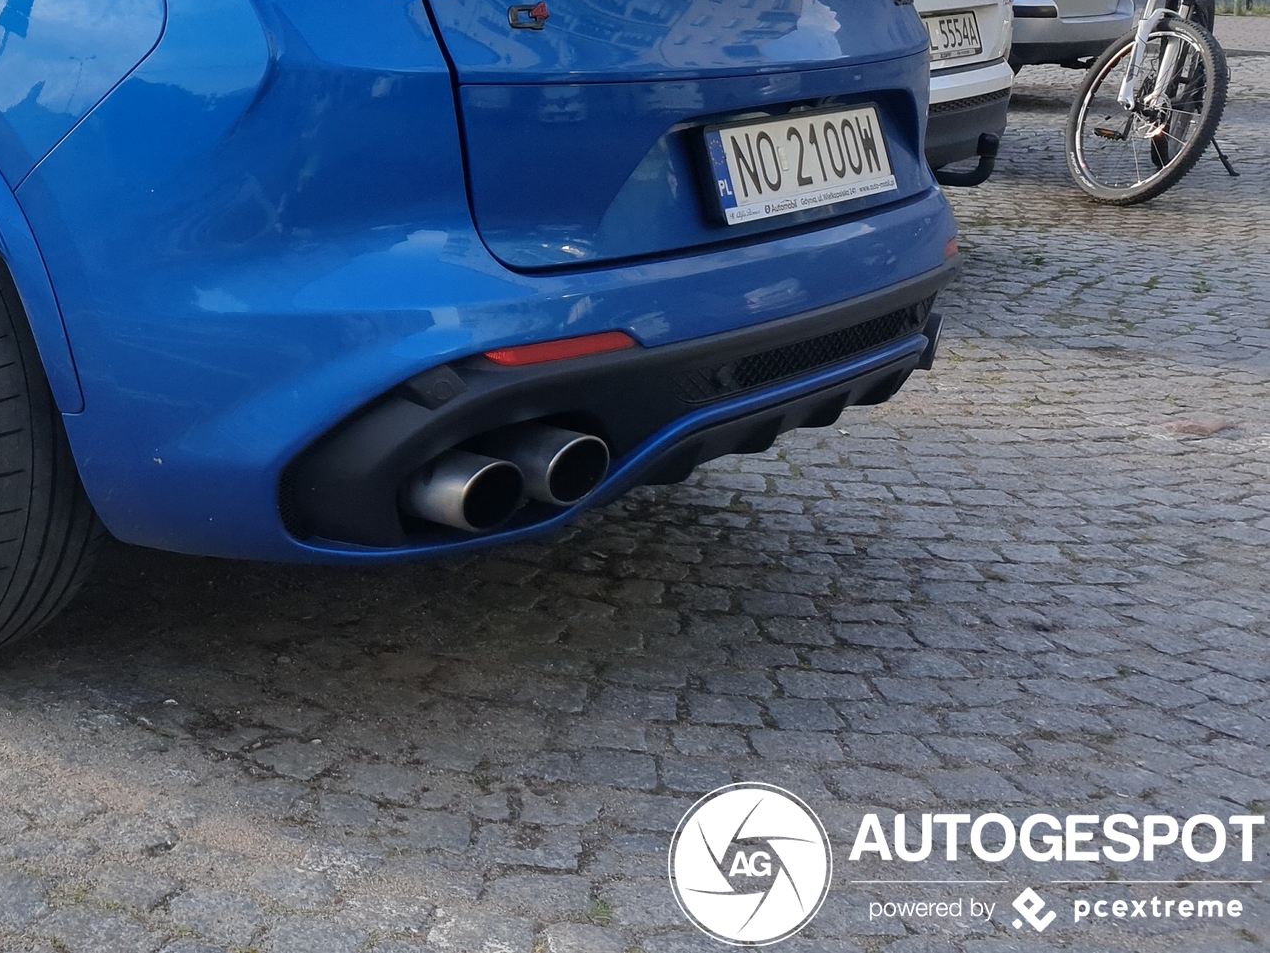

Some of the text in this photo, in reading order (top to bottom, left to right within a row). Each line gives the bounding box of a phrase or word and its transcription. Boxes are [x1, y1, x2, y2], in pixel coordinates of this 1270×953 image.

[938, 17, 979, 49] 5554A
[730, 114, 882, 198] NO 2100W
[718, 179, 733, 198] PL
